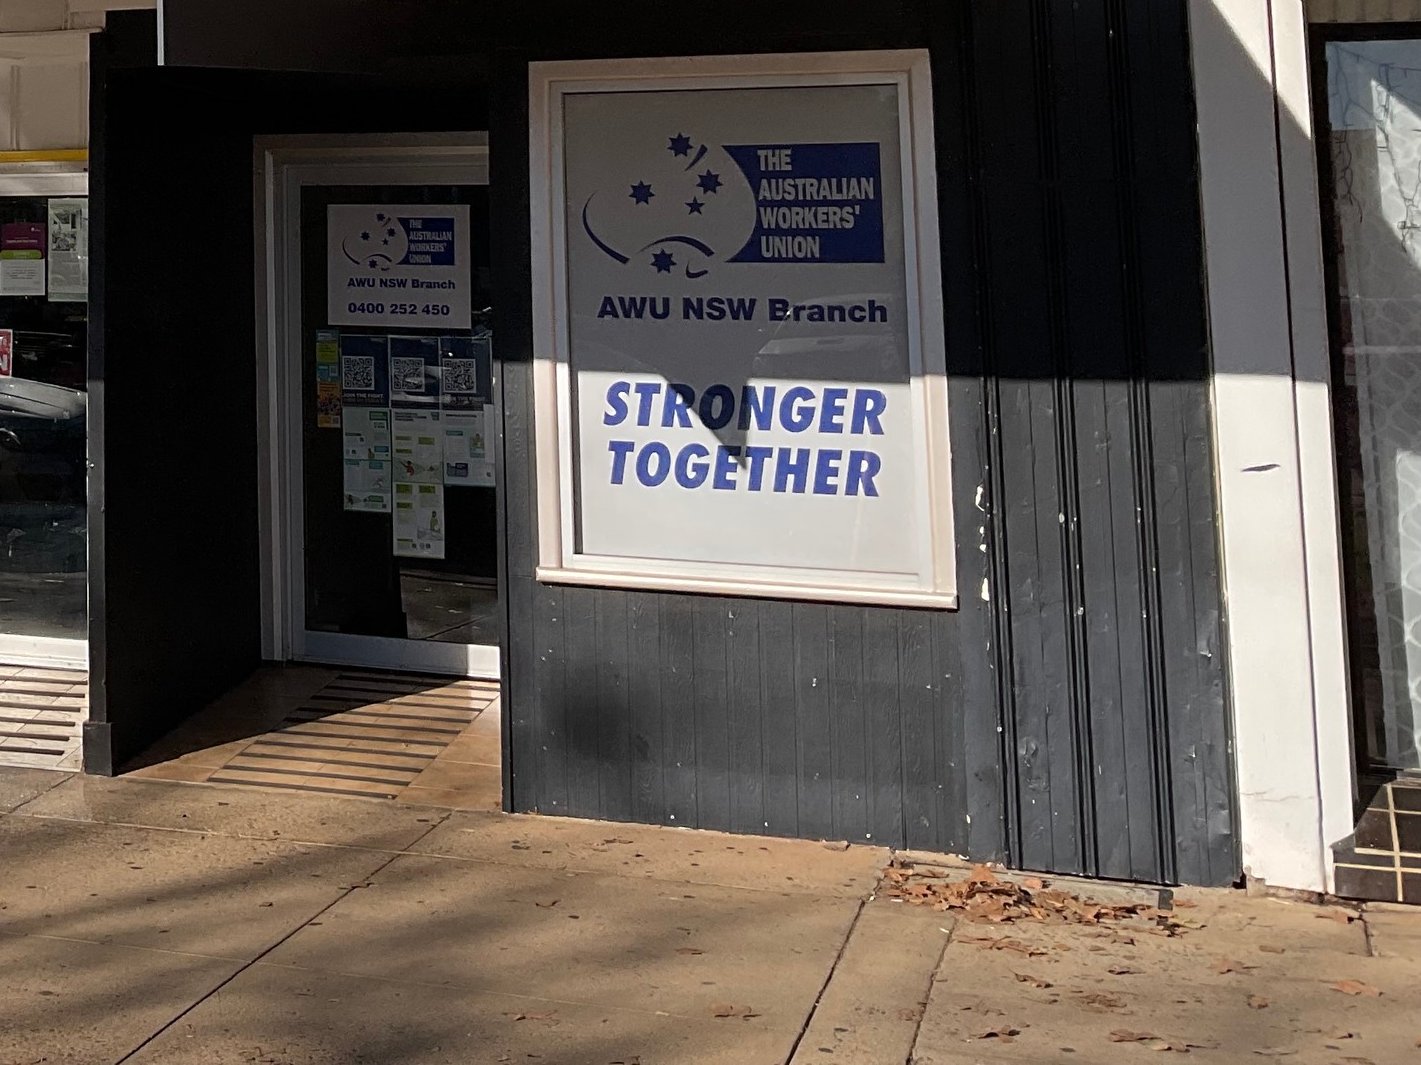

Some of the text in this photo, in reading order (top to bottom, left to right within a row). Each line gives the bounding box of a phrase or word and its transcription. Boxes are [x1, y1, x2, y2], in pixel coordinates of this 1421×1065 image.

[756, 148, 793, 171] THE
[758, 177, 874, 201] AUSTRALIAN
[409, 218, 422, 228] THE
[759, 205, 861, 230] WORKERS'
[409, 231, 453, 241] AUSTRALIAN
[760, 235, 820, 259] UNION
[409, 254, 432, 264] UNION
[347, 277, 456, 289] AWU NSW Branch
[347, 302, 450, 315] 0400 252 450
[598, 296, 888, 323] AWU NSW Branch
[602, 380, 888, 436] STRONGER
[608, 439, 882, 498] TOGETHER
